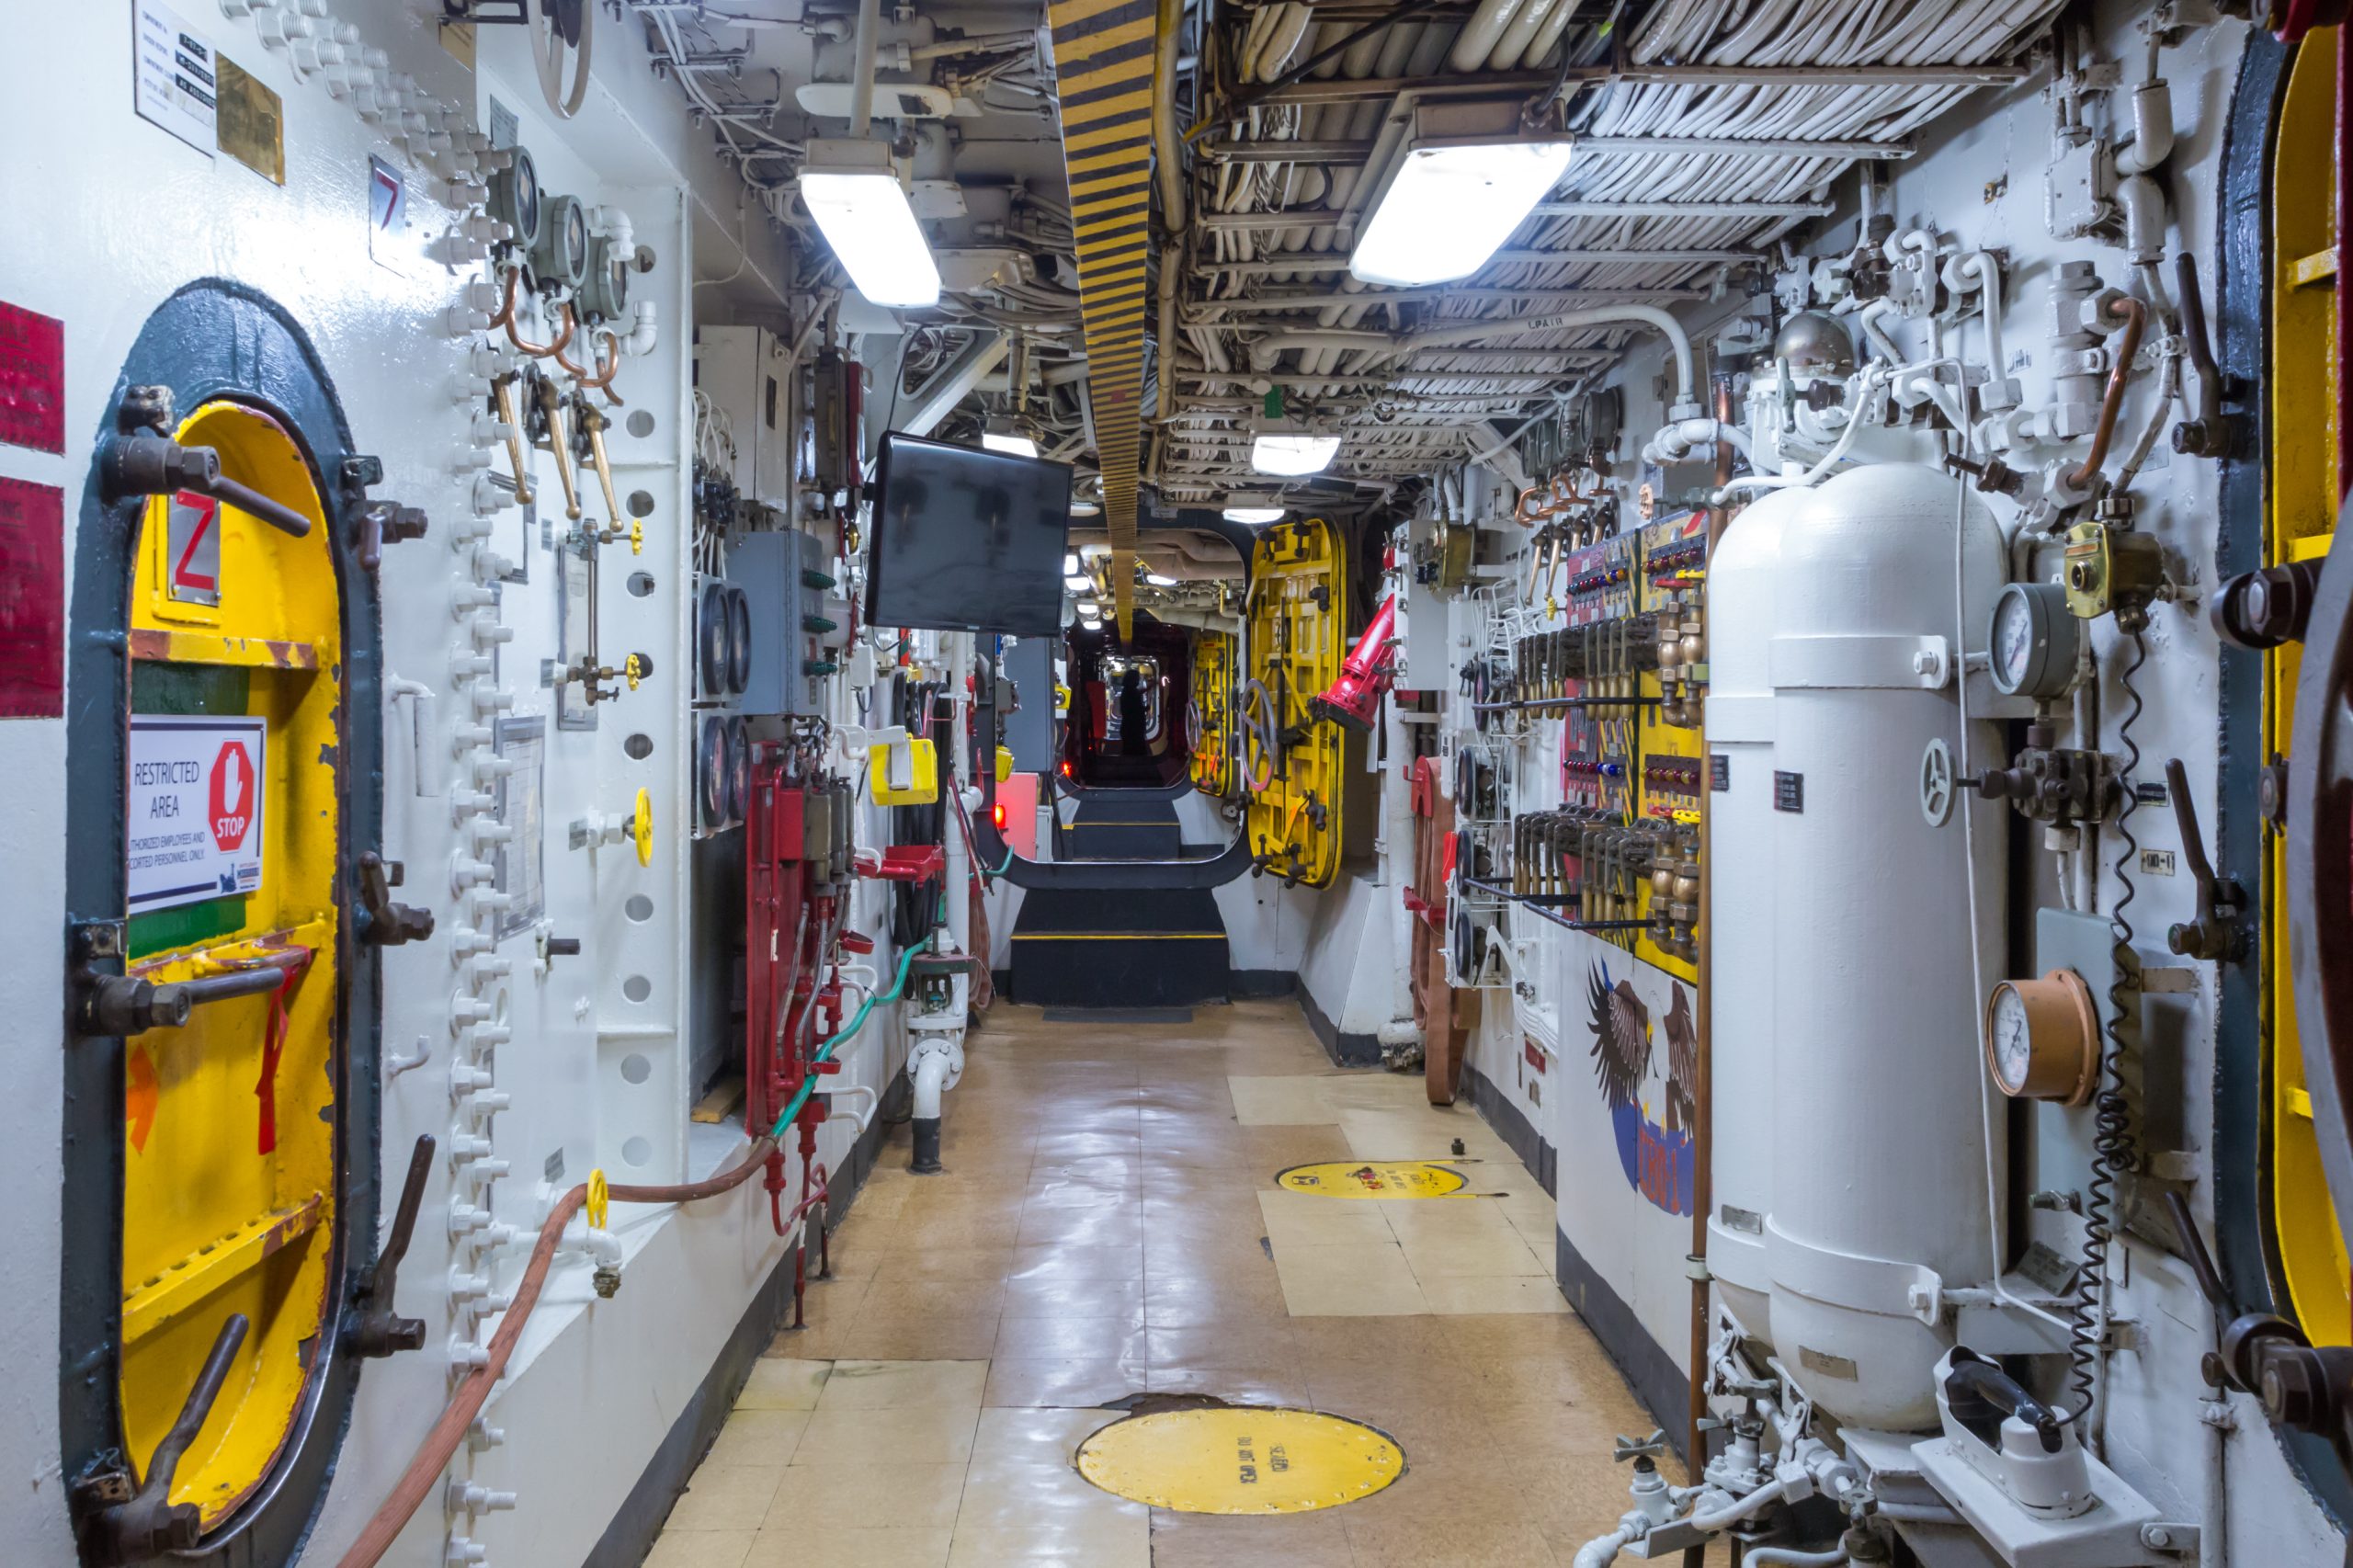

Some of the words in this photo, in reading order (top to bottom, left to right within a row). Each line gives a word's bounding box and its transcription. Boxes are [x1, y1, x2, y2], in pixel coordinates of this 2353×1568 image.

[134, 761, 200, 787] RESTRICTED
[150, 795, 180, 819] AREA
[216, 816, 245, 838] STOP
[130, 836, 160, 852] THORIZED
[161, 832, 192, 848] EMPLOYEES
[193, 831, 206, 844] AND
[130, 855, 153, 870] CORTED
[154, 851, 188, 867] PERSONNEL
